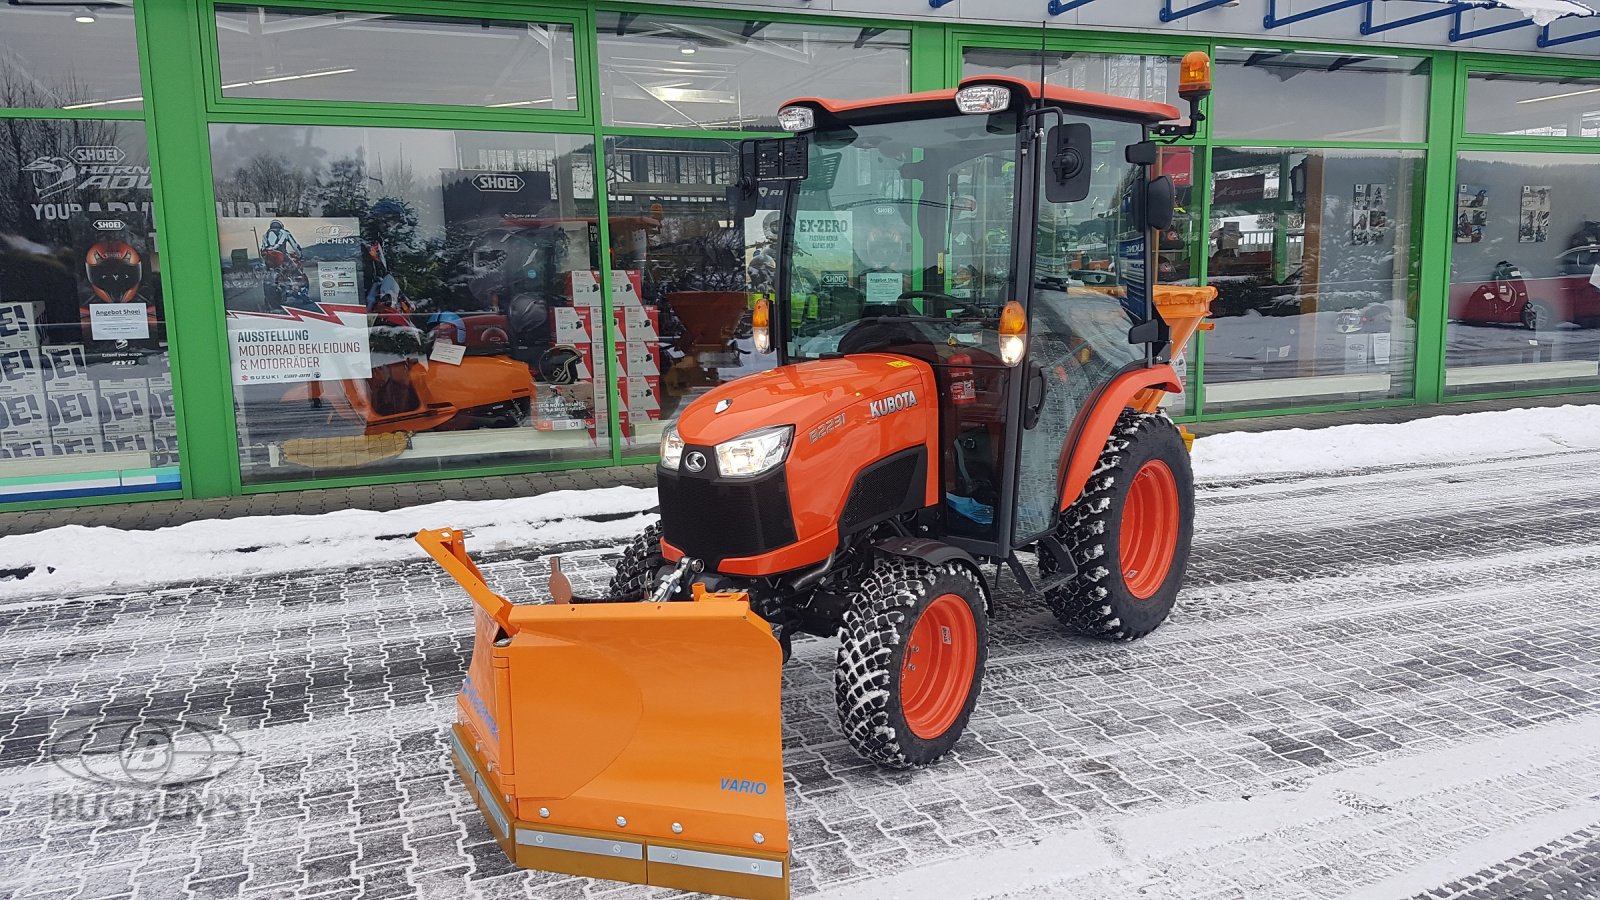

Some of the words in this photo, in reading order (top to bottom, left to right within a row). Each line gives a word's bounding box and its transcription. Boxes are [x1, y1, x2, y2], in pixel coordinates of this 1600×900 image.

[78, 149, 118, 161] SHOEI
[480, 179, 518, 189] SHOEI
[97, 221, 121, 229] SHOEI
[799, 220, 848, 233] EX-ZERO
[238, 330, 309, 343] AUSSTELLUNG
[239, 343, 296, 357] MOTORRAD
[299, 341, 360, 355] BEKLEIDUNG
[240, 359, 248, 370] &
[250, 356, 320, 370] MOTORRÄDER
[869, 390, 918, 418] KUBOTA
[721, 778, 767, 795] VARIO
